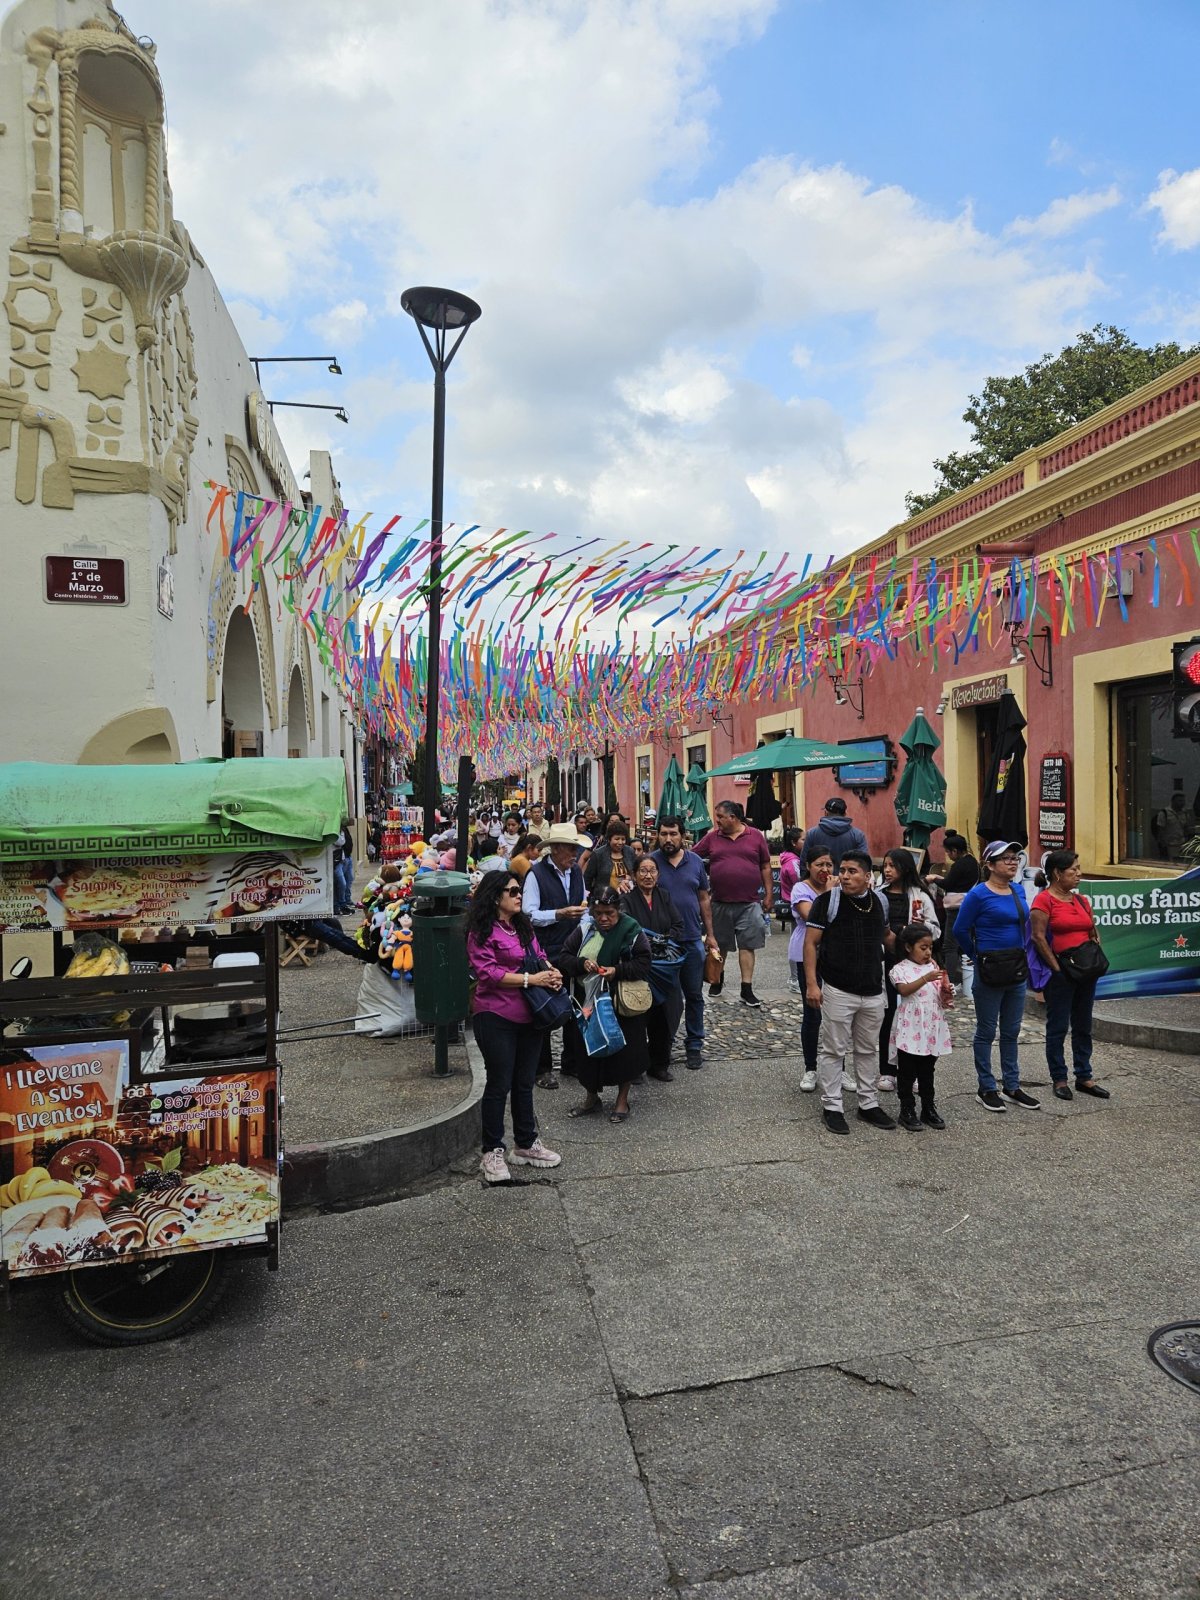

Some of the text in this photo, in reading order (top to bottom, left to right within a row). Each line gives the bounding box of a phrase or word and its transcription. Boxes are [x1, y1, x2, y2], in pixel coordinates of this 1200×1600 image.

[75, 561, 97, 569] Calle
[87, 573, 101, 581] de
[69, 582, 103, 592] Marzo
[952, 679, 997, 709] Revolución
[1150, 888, 1200, 909] fans
[1135, 910, 1161, 925] los
[1164, 909, 1200, 924] fans
[1160, 950, 1200, 960] Heineken
[182, 1081, 248, 1094] Contactanos
[31, 1091, 45, 1106] A
[164, 1090, 261, 1109] 967 109 3129
[164, 1109, 222, 1122] Marquesitas
[231, 1105, 265, 1118] Crepas
[165, 1119, 206, 1134] De Jovel
